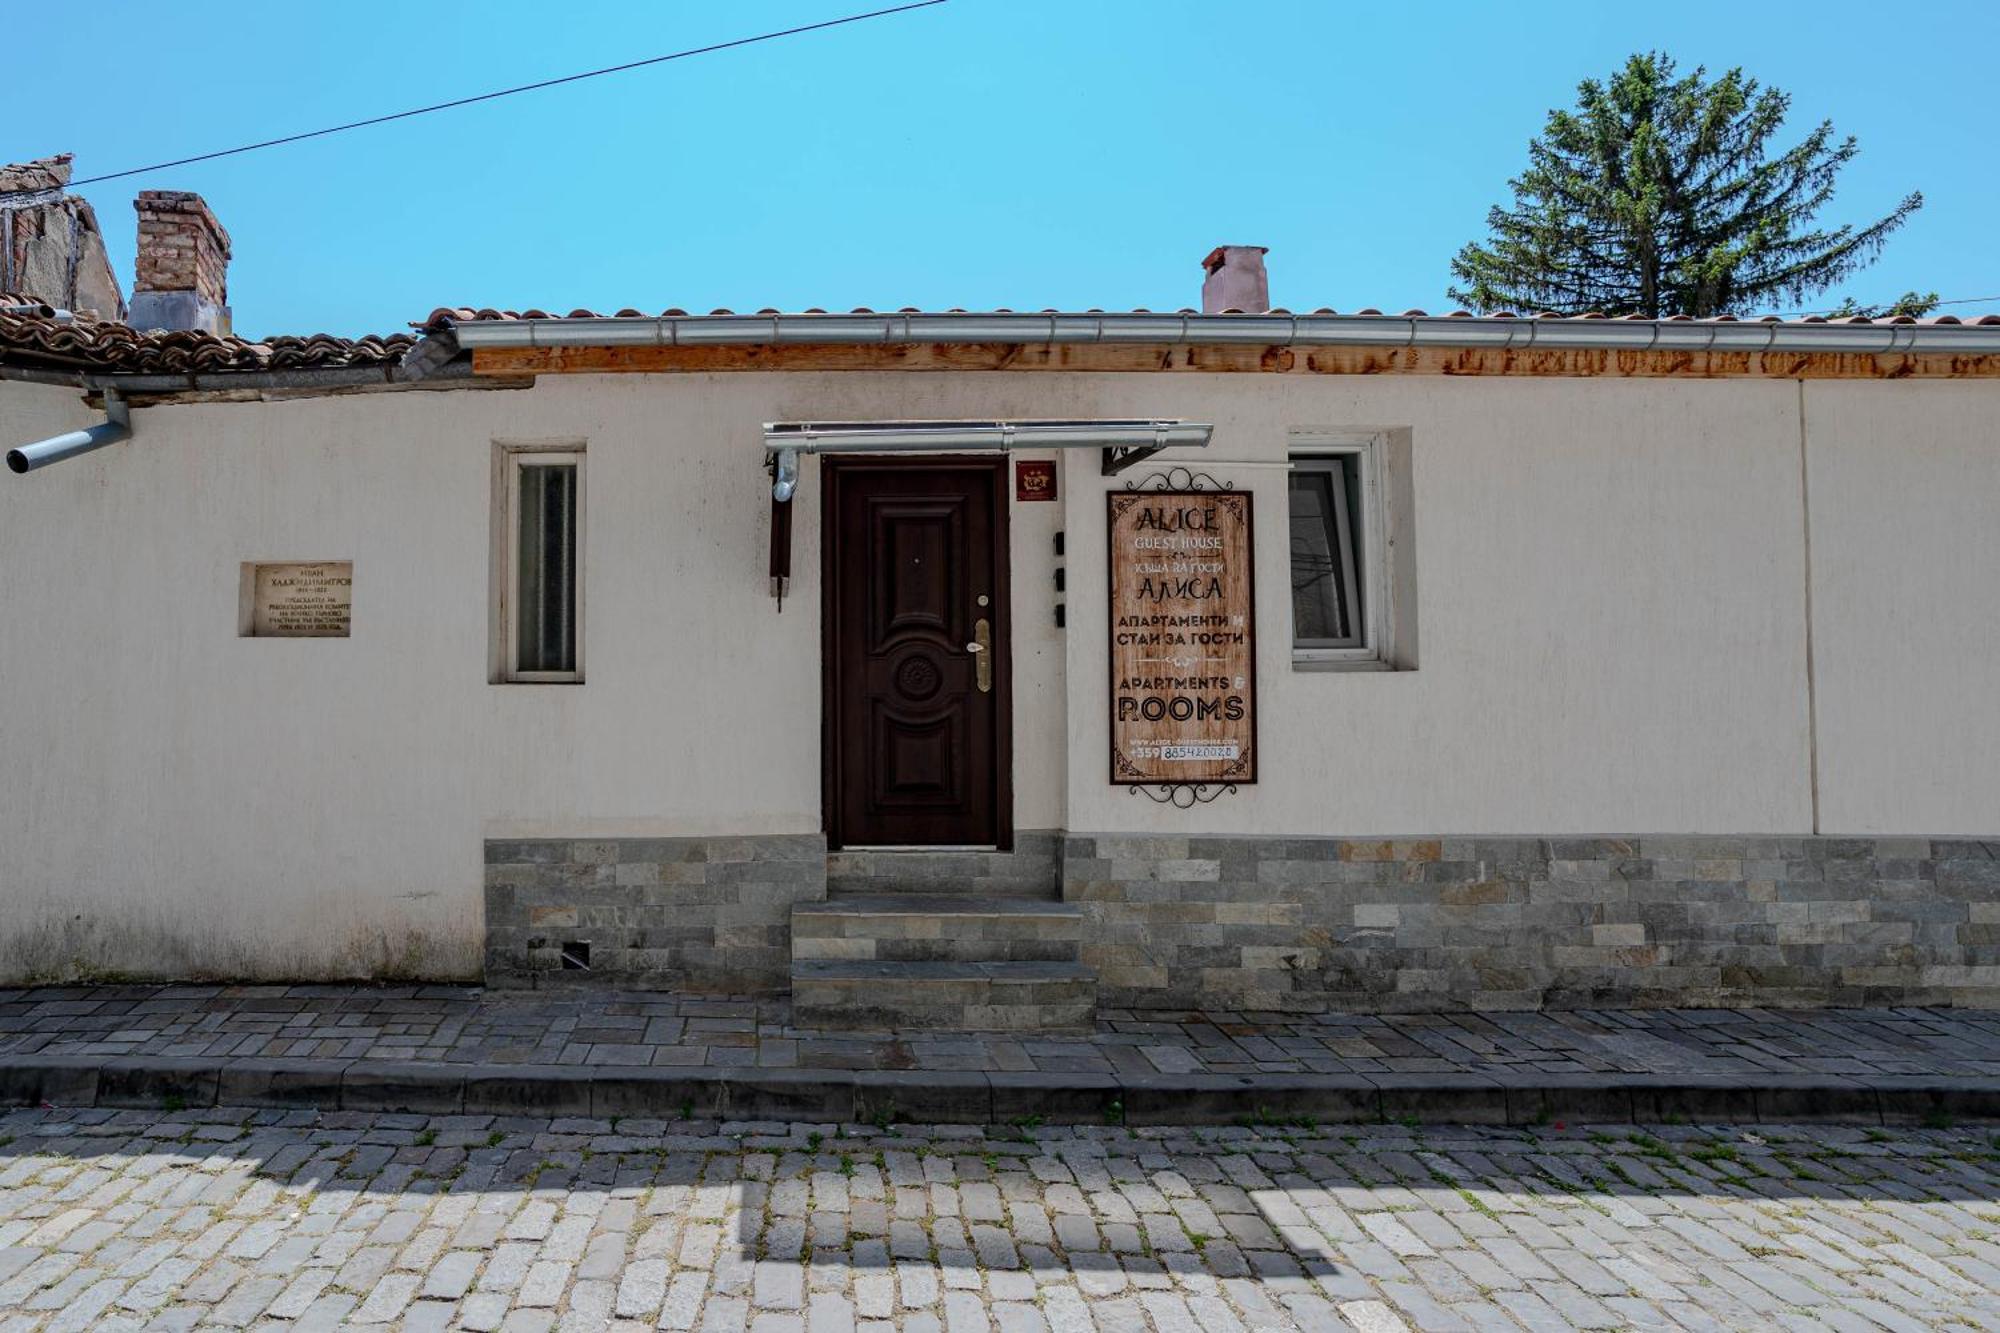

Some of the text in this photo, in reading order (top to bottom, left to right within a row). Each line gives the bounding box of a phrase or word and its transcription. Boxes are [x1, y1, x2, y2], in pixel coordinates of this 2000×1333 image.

[1136, 507, 1220, 533] ALICE
[1135, 536, 1224, 549] GUEST HOUSE
[1137, 577, 1225, 604] АЛИСА
[1118, 615, 1229, 627] АПАРТАМЕНТИ
[1117, 633, 1244, 645] СТАИ ЗА ГОСТИ
[1119, 677, 1230, 690] APARTMENTS
[1118, 696, 1245, 722] ROOMS
